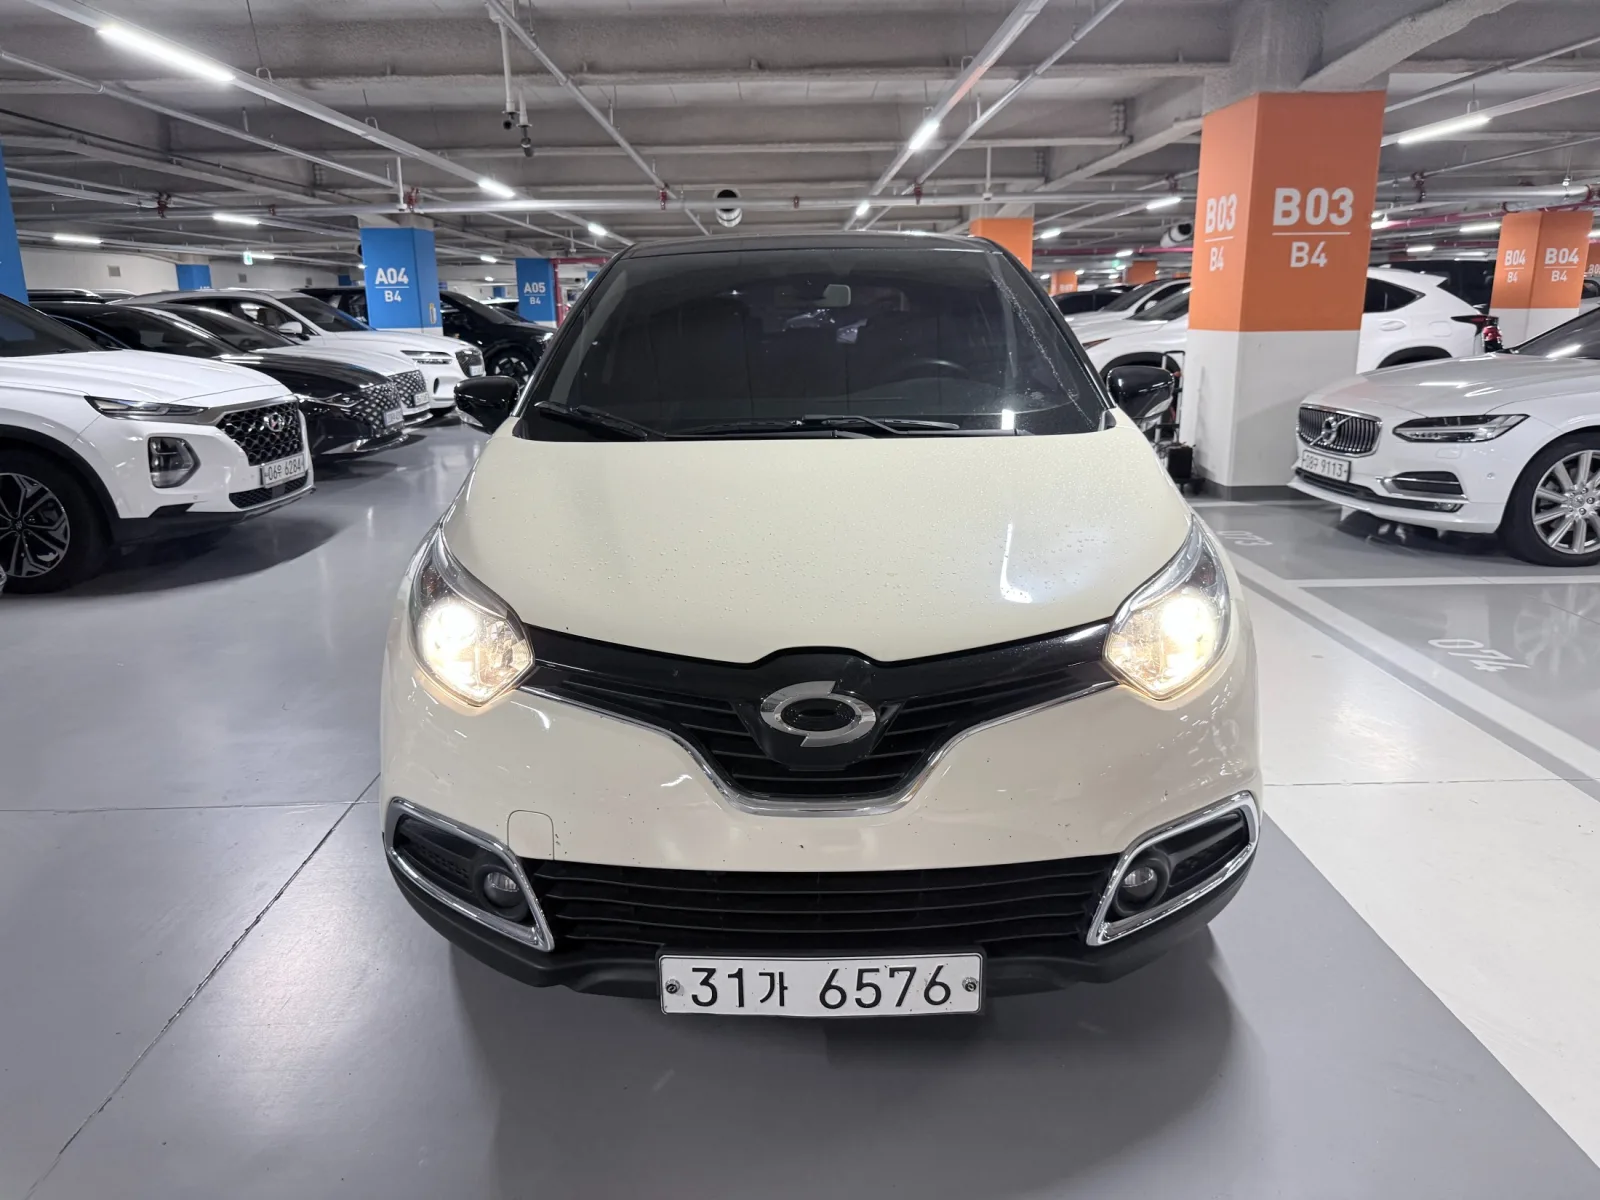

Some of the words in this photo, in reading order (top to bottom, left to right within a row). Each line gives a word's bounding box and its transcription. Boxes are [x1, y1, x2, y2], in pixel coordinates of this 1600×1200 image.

[1205, 194, 1237, 234] B03
[1273, 187, 1354, 226] B03
[1210, 246, 1224, 272] B4
[1290, 242, 1328, 268] B4
[1504, 249, 1526, 266] B04
[1544, 248, 1579, 265] B04
[375, 267, 409, 285] A04
[1507, 271, 1518, 283] B4
[1551, 270, 1567, 282] B4
[1587, 263, 1600, 275] B0
[384, 290, 402, 302] B4
[523, 282, 546, 293] A05
[529, 296, 541, 305] B4
[285, 458, 301, 475] 6284
[1321, 459, 1343, 477] 9113
[1427, 639, 1530, 672] 074
[691, 967, 788, 1008] 31가
[819, 965, 951, 1009] 6576
